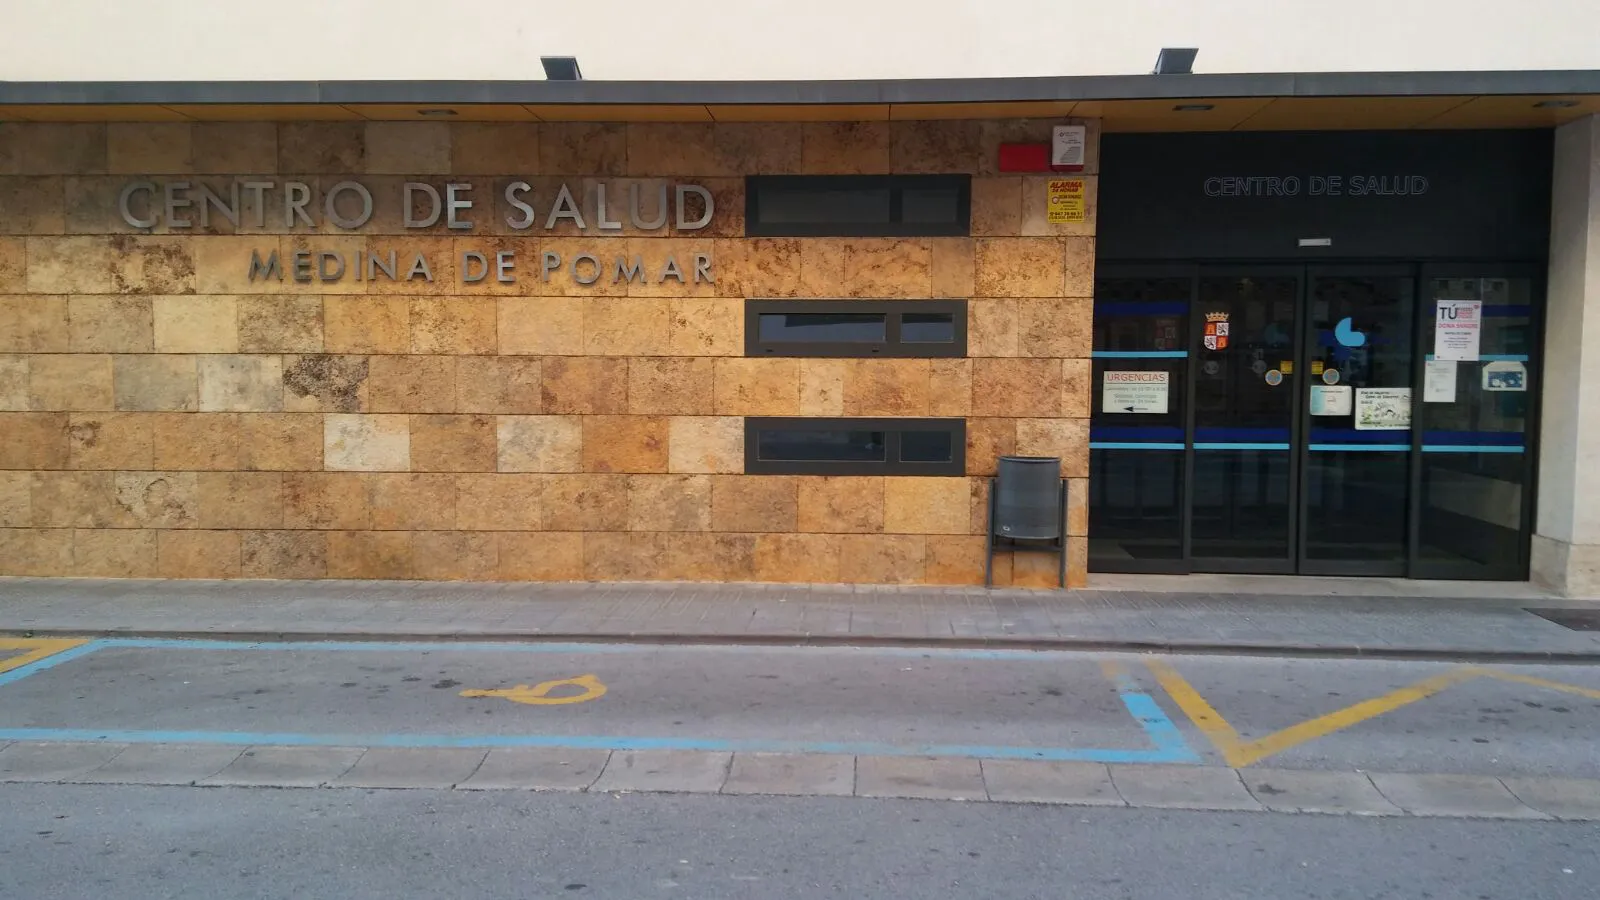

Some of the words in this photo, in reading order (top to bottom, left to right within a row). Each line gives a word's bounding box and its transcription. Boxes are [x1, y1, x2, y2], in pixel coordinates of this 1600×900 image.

[1204, 176, 1301, 196] CENTRO
[1308, 176, 1342, 195] DE
[1349, 175, 1428, 195] SALUD
[118, 180, 374, 230] CENTRO
[403, 182, 474, 230] DE
[504, 180, 716, 231] SALUD
[248, 249, 434, 283] MEDINA
[461, 250, 517, 283] DE
[541, 251, 717, 285] POMAR
[1439, 304, 1457, 319] TÚ
[1107, 373, 1166, 382] URGENCIAS
